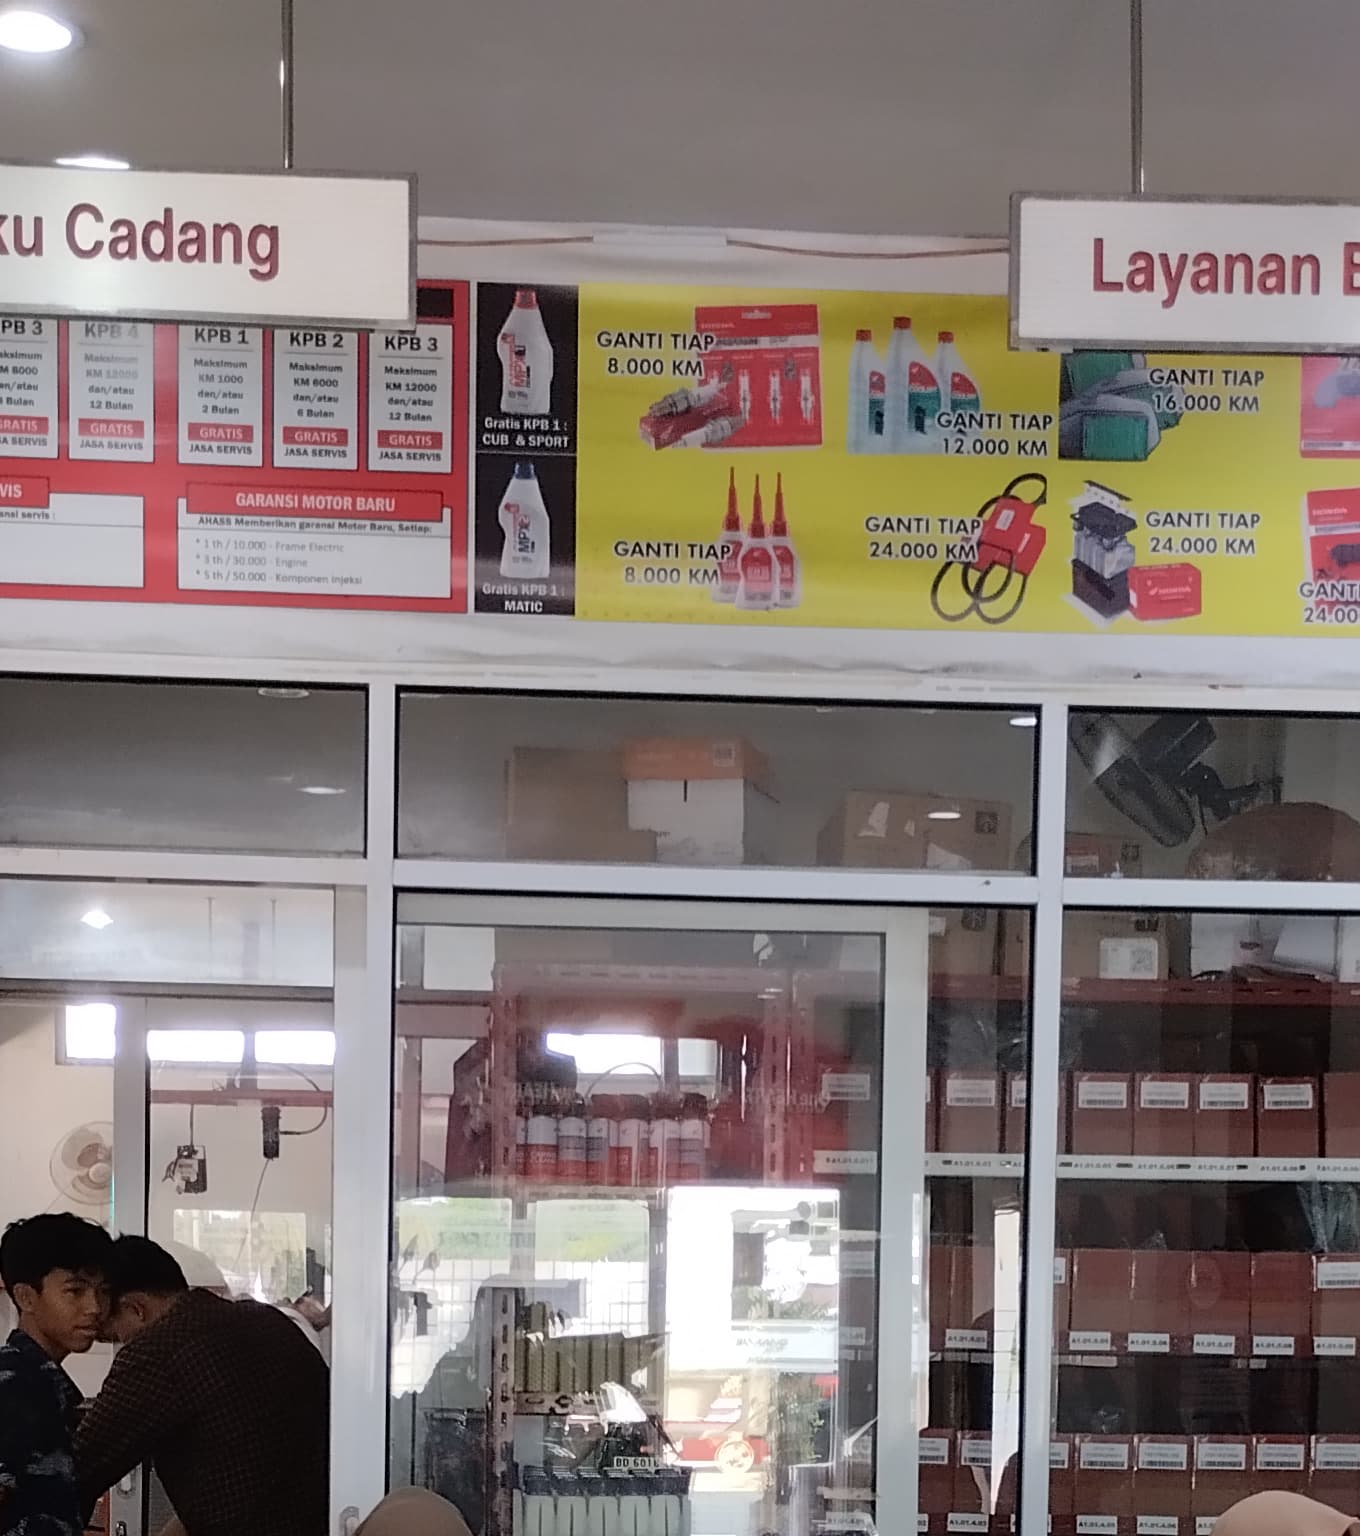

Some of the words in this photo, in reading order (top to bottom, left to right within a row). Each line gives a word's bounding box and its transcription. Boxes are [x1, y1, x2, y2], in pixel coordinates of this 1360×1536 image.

[65, 203, 281, 280] Cadang
[1092, 237, 1321, 310] Layanan
[32, 320, 43, 335] 3
[84, 323, 122, 338] KPB
[195, 328, 232, 344] KPB
[237, 330, 249, 344] 1
[290, 332, 326, 348] KPB
[333, 334, 344, 348] 2
[385, 336, 421, 351] KPB
[427, 337, 438, 351] 3
[597, 331, 663, 349] GANTI
[671, 333, 714, 351] TIAP
[608, 359, 664, 375] 8.000
[672, 361, 703, 377] KM
[199, 374, 215, 383] KM
[218, 375, 244, 384] 1000
[294, 378, 310, 387] KM
[1149, 369, 1214, 386] GANTI
[1222, 371, 1265, 388] TIAP
[385, 382, 402, 391] KM
[405, 383, 437, 392] 12000
[1154, 394, 1221, 411] 16.000
[1229, 396, 1259, 412] KM
[90, 423, 134, 435] GRATIS
[484, 417, 520, 431] Gratis
[523, 419, 551, 431] KPB
[553, 420, 559, 431] 1
[937, 413, 1003, 430] GANTI
[1010, 415, 1053, 431] TIAP
[199, 427, 243, 439] GRATIS
[294, 431, 338, 443] GRATIS
[389, 434, 432, 446] GRATIS
[482, 434, 509, 447] CUB
[516, 435, 526, 447] &
[528, 435, 568, 448] SPORT
[943, 438, 1009, 455] 12.000
[1017, 440, 1047, 456] KM
[379, 452, 403, 461] JASA
[406, 452, 441, 462] SERVIS
[236, 493, 298, 508] GARANSI
[302, 495, 353, 510] MOTOR
[356, 497, 395, 512] BARU
[865, 517, 930, 534] GANTI
[938, 518, 981, 536] TIAP
[1146, 511, 1211, 529] GANTI
[1219, 513, 1261, 529] TIAP
[614, 541, 679, 559] GANTI
[688, 543, 731, 559] TIAP
[869, 542, 937, 559] 24.000
[945, 544, 978, 560] KM
[1150, 537, 1218, 554] 24.000
[1225, 539, 1255, 555] KM
[624, 567, 681, 584] 8.000
[689, 568, 719, 585] KM
[482, 583, 519, 596] Gratis
[522, 584, 548, 597] KPB
[551, 584, 558, 597] 1
[504, 600, 543, 613] MATIC
